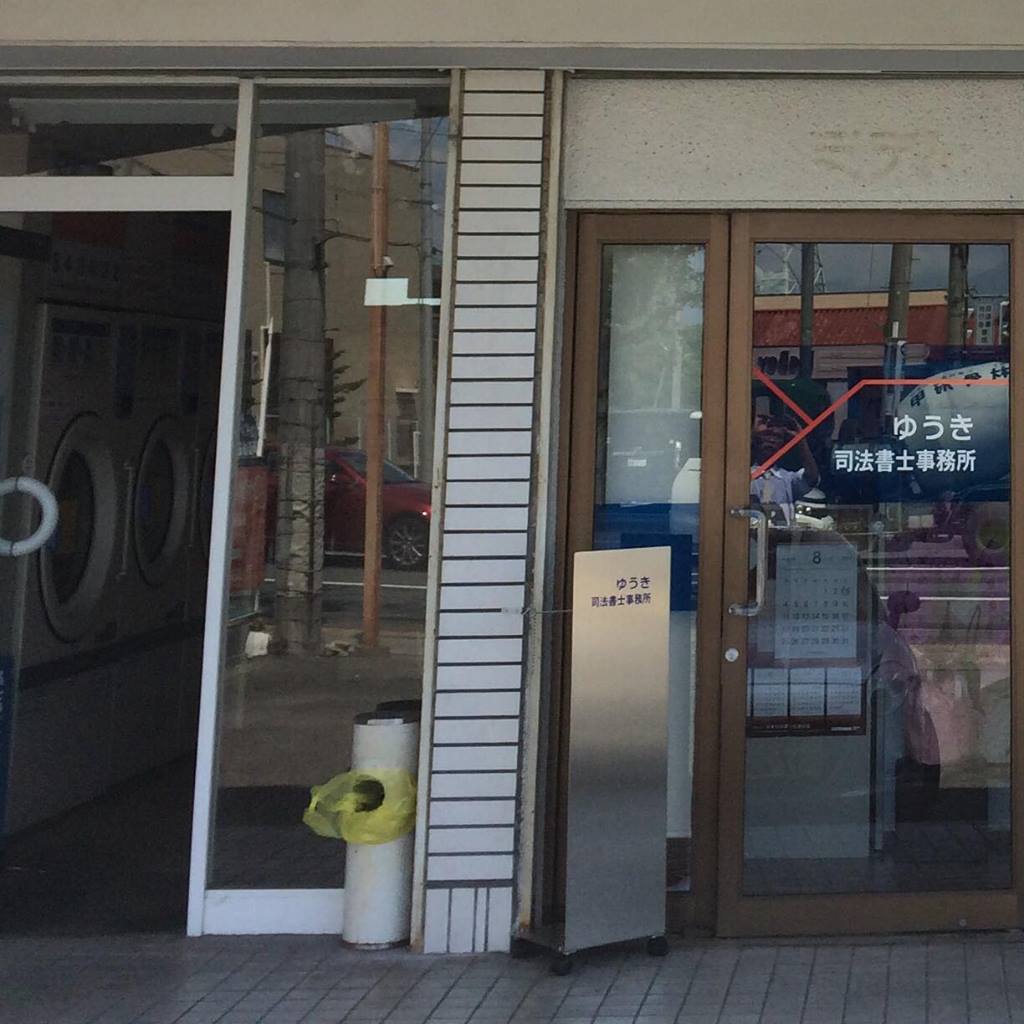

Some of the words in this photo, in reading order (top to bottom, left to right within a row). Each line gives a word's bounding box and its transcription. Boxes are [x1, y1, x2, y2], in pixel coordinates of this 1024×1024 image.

[892, 414, 974, 441] ゆうき
[834, 449, 977, 473] 司法書士事務所
[812, 551, 822, 565] 8
[616, 576, 651, 590] ゆうき
[591, 592, 652, 607] 司法書士事務所
